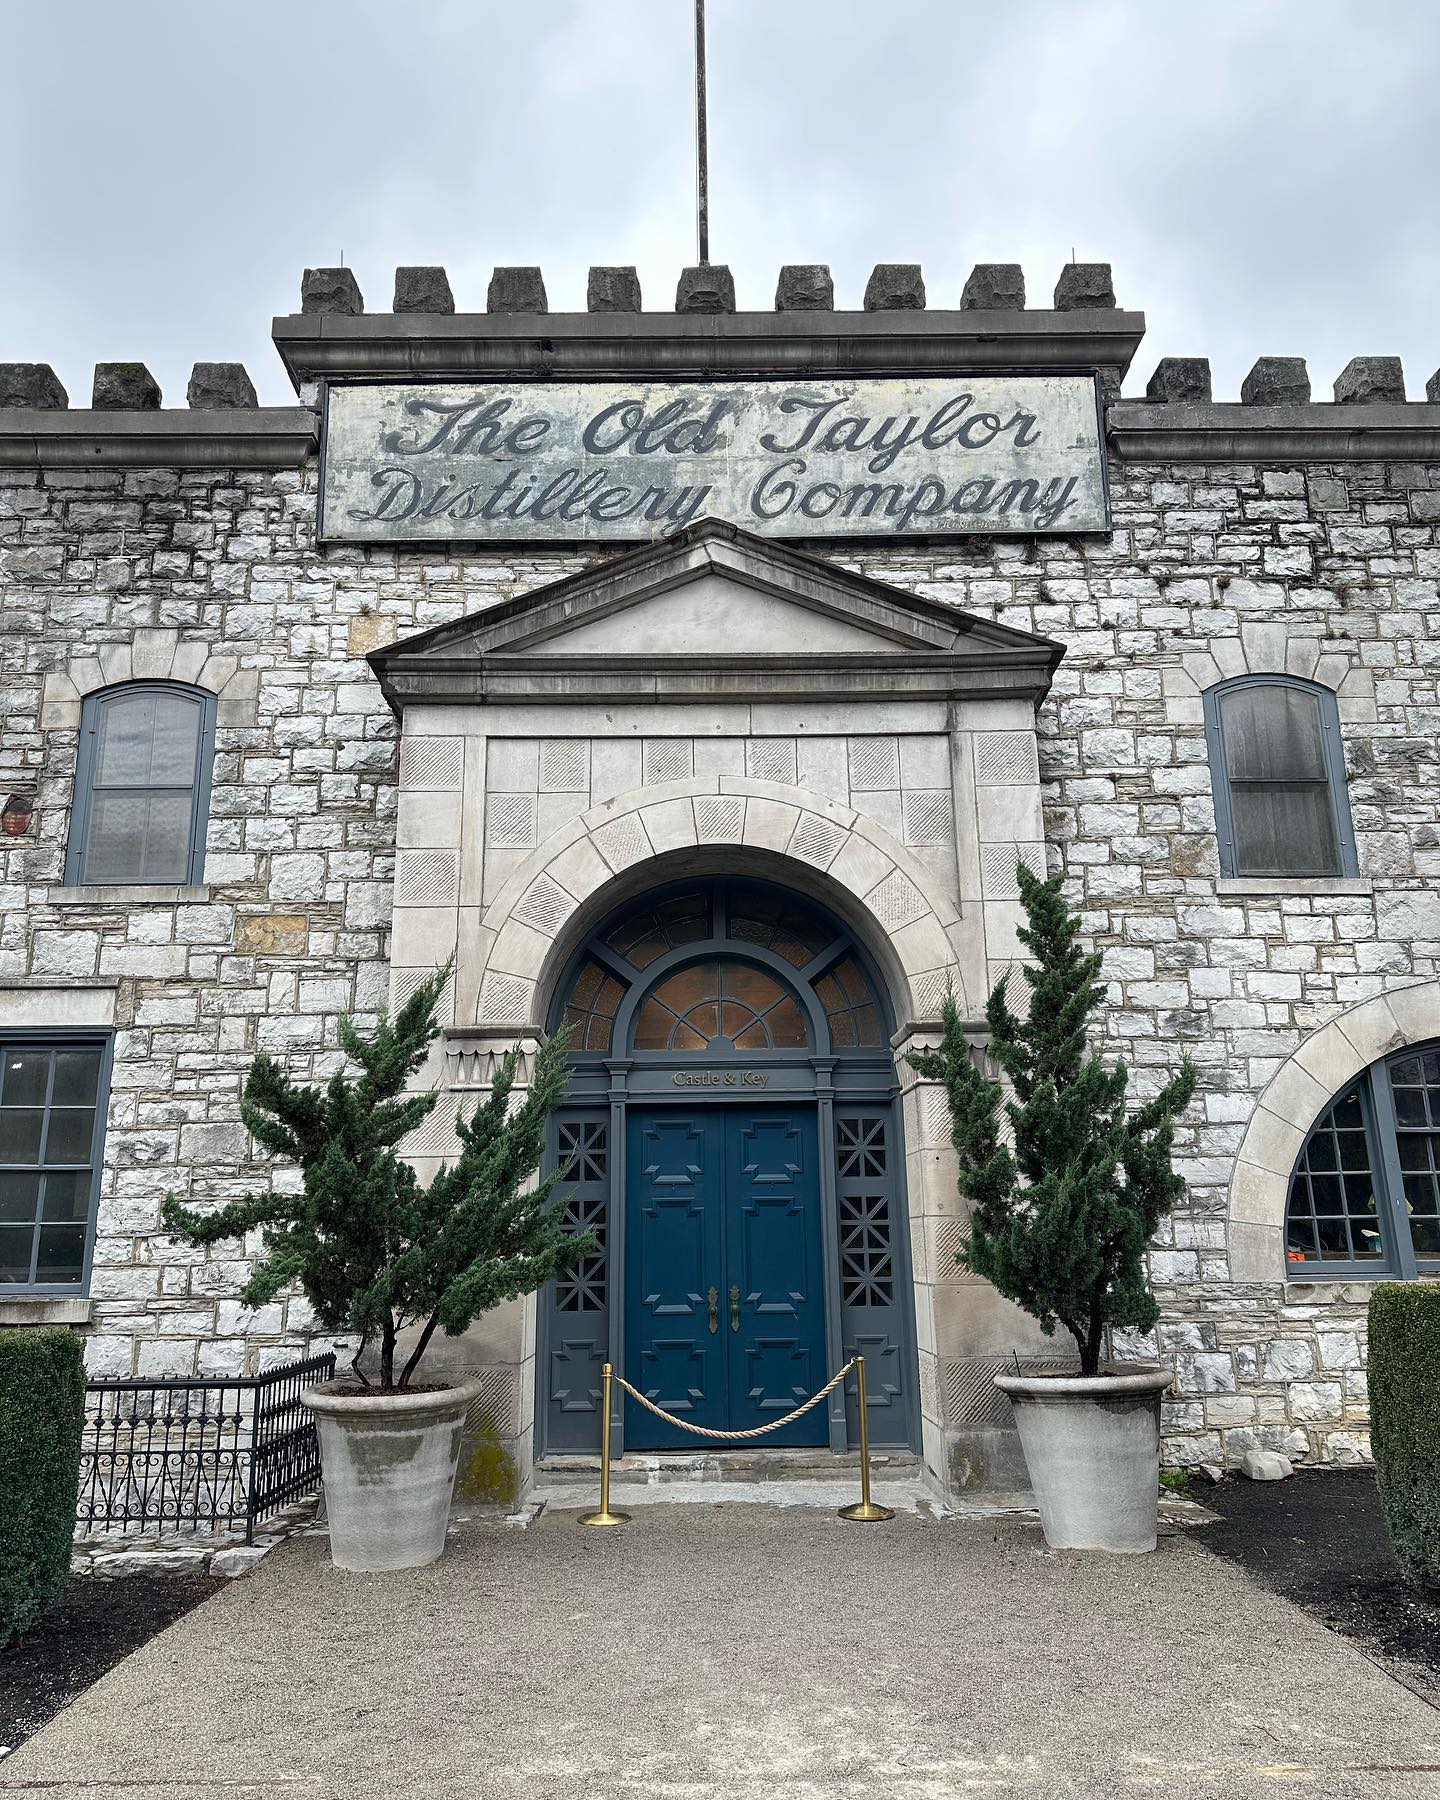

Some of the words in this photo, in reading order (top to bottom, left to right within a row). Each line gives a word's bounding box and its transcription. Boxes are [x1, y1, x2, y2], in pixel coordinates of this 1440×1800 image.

[384, 399, 551, 456] The
[582, 399, 731, 455] Old
[760, 393, 1042, 474] Taylor
[346, 467, 713, 538] Distillery
[751, 458, 1079, 530] Company
[672, 1071, 720, 1086] Castle
[723, 1071, 736, 1086] &
[741, 1071, 769, 1089] Key
